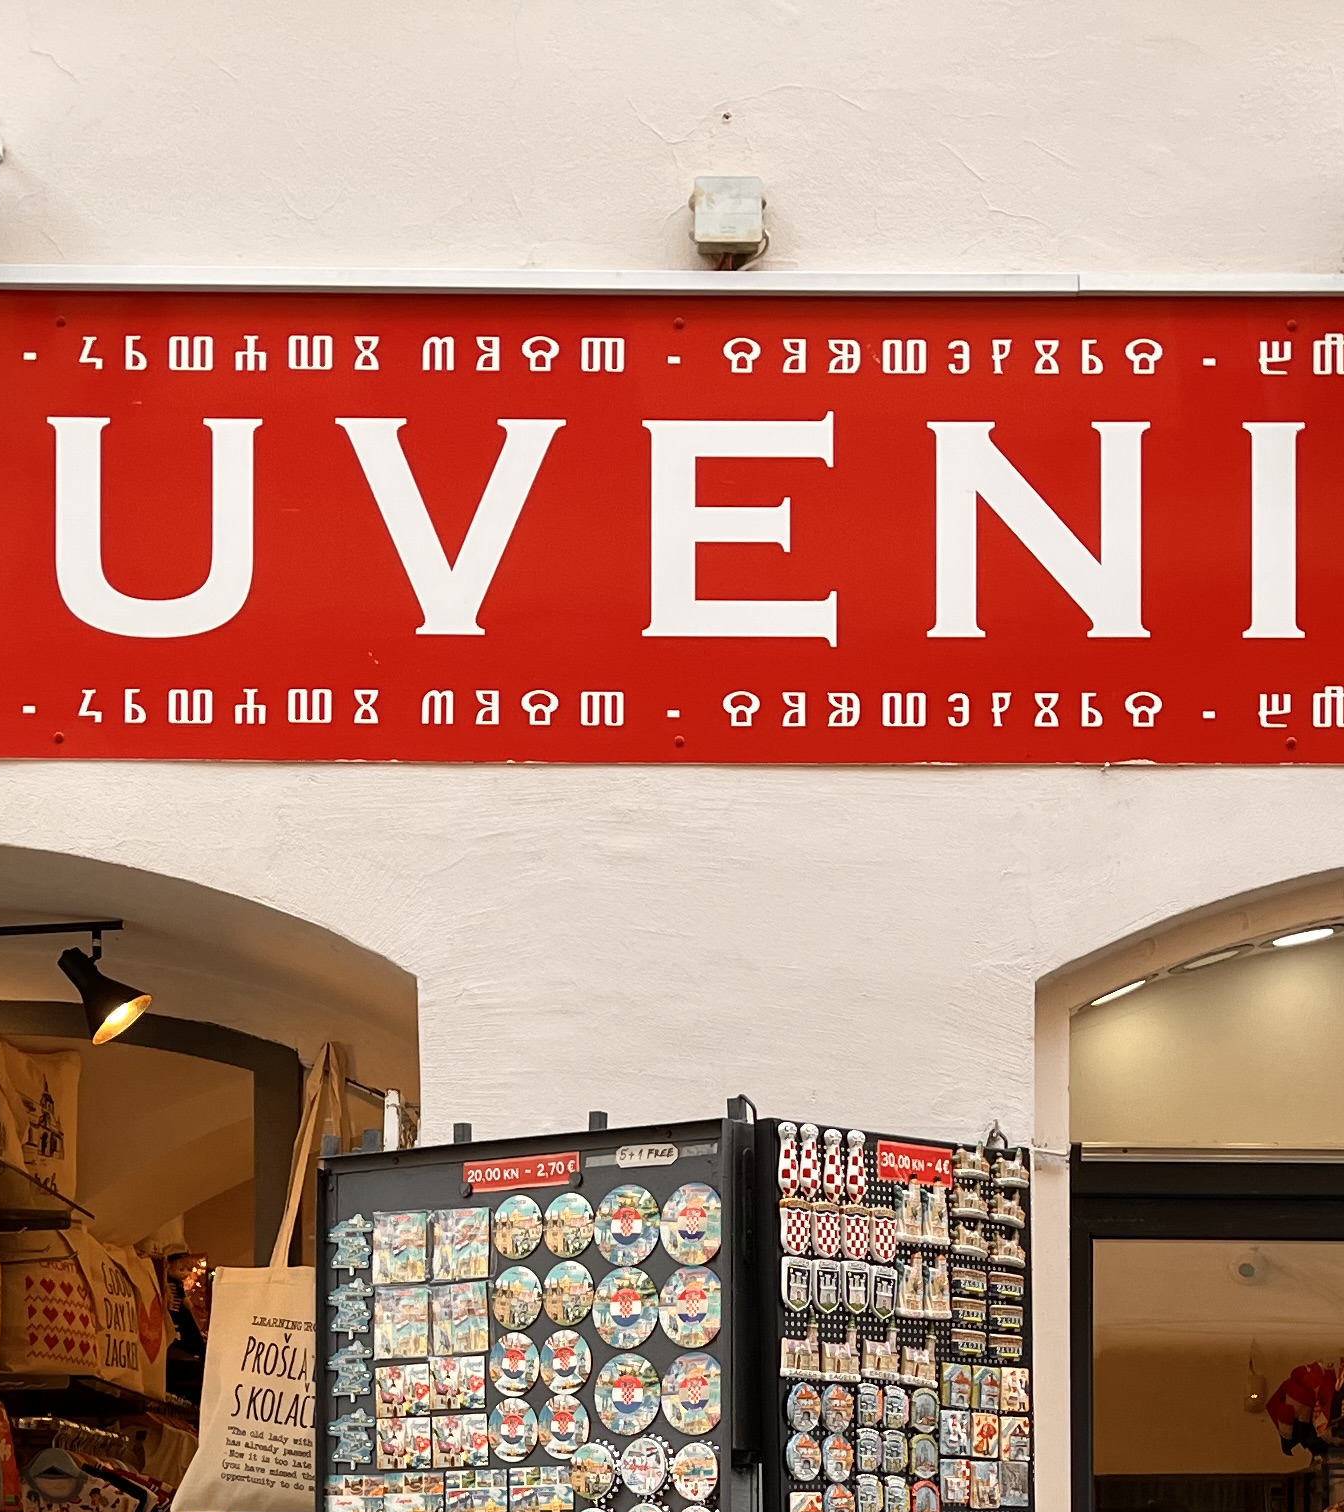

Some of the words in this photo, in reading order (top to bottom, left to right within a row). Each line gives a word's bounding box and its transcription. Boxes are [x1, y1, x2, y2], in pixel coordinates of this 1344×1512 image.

[647, 1144, 674, 1158] FREE
[467, 1167, 501, 1183] 20,00
[503, 1165, 519, 1179] KN
[537, 1162, 564, 1179] 2,70
[567, 1159, 576, 1173] €
[880, 1152, 911, 1170] 30,00
[911, 1158, 925, 1172] KN
[251, 1315, 302, 1331] LEARNING
[240, 1332, 308, 1381] PROŠLA
[230, 1383, 243, 1417] S
[225, 1437, 241, 1446] has
[244, 1441, 279, 1454] already
[283, 1448, 311, 1458] passed
[268, 1432, 289, 1445] lady
[293, 1437, 313, 1447] with
[248, 1452, 257, 1461] it
[261, 1455, 270, 1463] is
[274, 1456, 288, 1466] too
[292, 1459, 312, 1469] late
[244, 1463, 265, 1473] have
[269, 1468, 297, 1479] missed
[220, 1472, 276, 1488] opportunity
[280, 1480, 290, 1488] to
[293, 1482, 304, 1490] do
